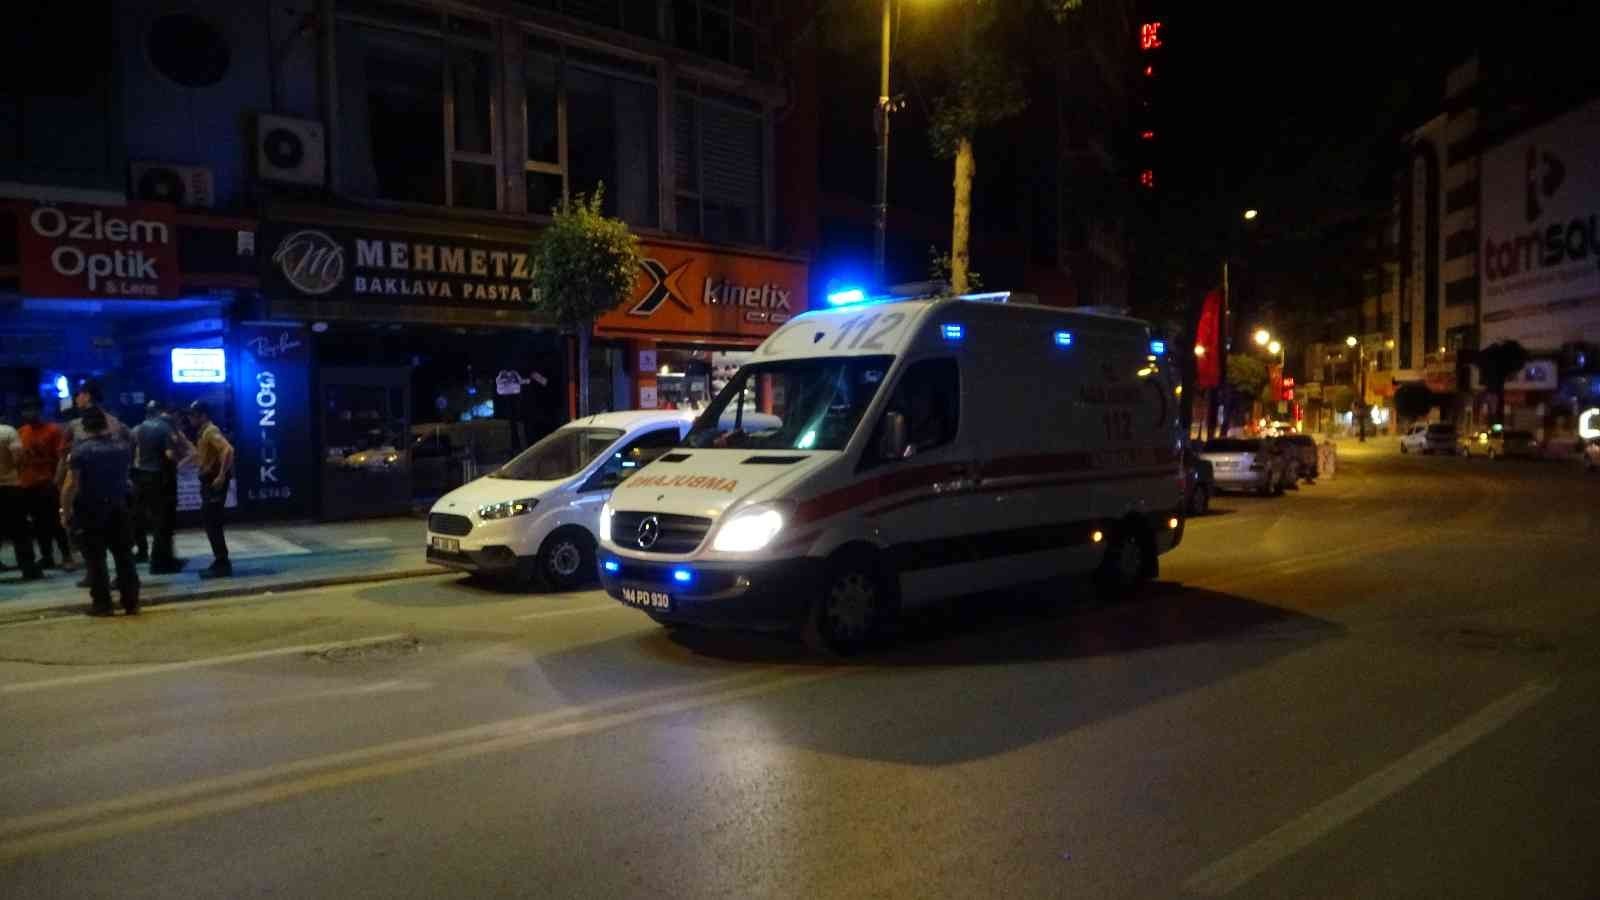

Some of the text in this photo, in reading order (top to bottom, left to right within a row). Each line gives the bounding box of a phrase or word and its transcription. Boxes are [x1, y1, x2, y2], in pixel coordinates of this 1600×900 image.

[31, 201, 169, 244] Özlem
[51, 245, 160, 291] Optik
[354, 276, 452, 297] BAKLAVA
[463, 282, 522, 302] PASTA
[704, 276, 792, 309] kinetix
[829, 311, 906, 350] 112
